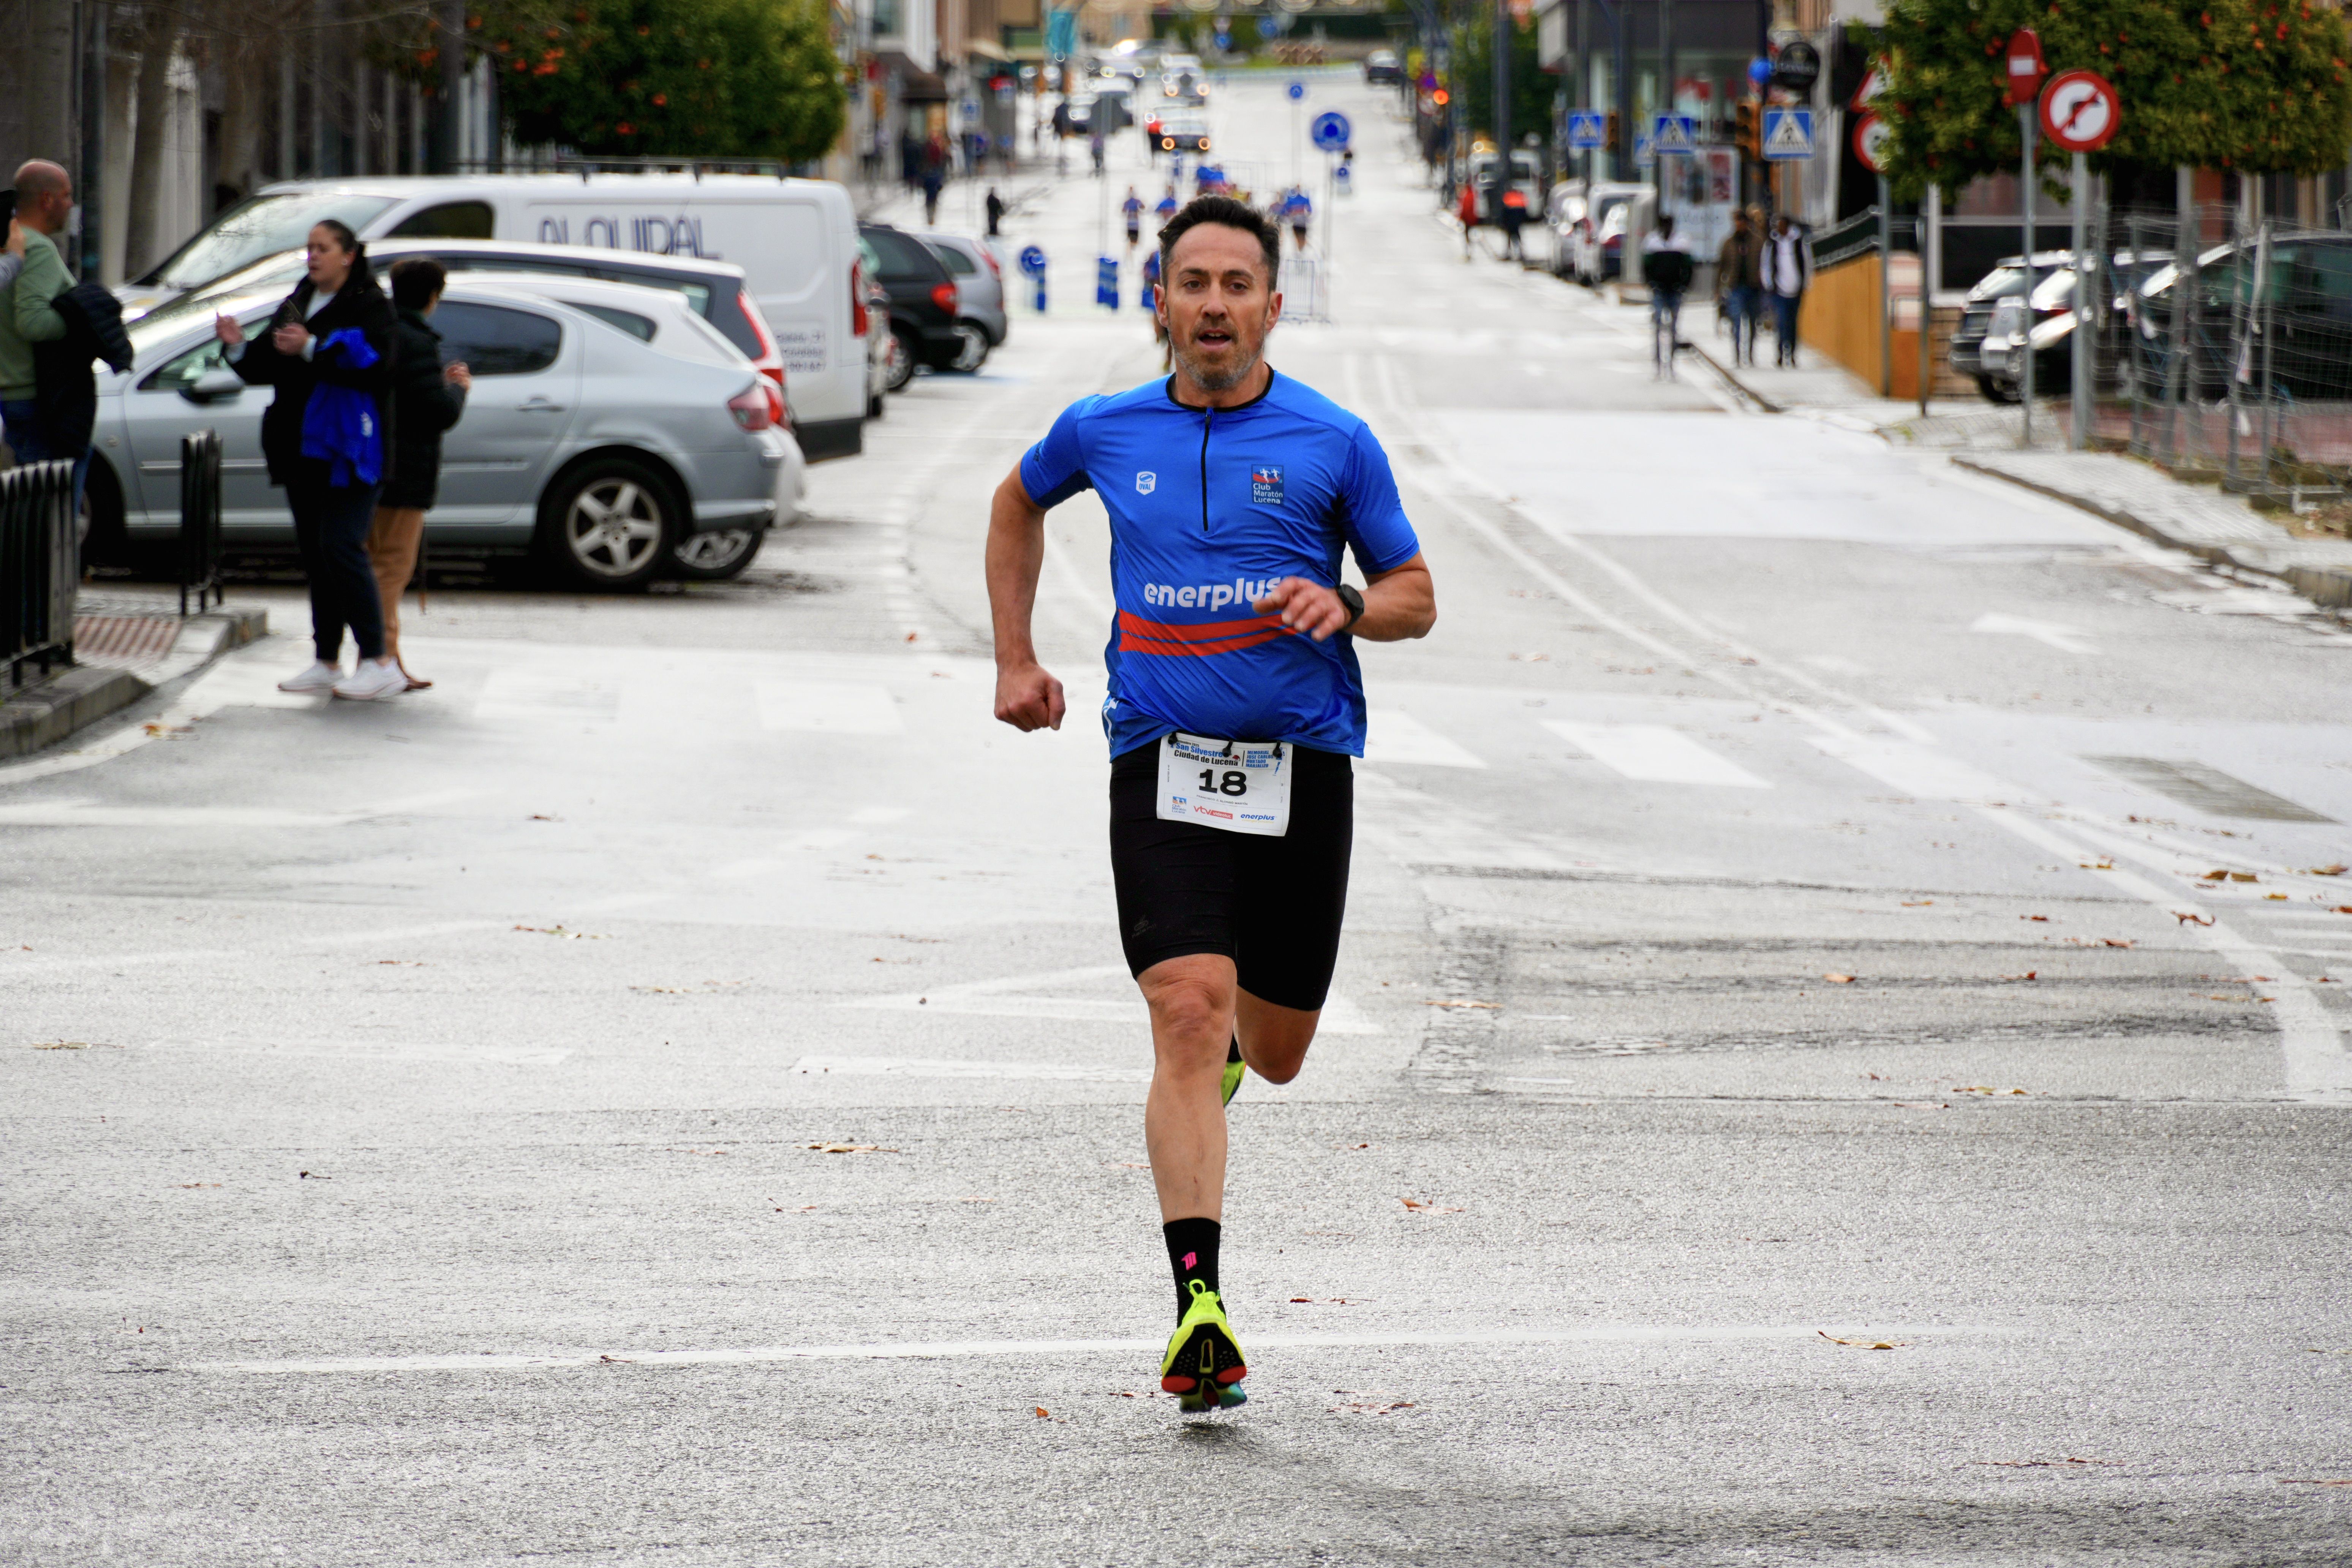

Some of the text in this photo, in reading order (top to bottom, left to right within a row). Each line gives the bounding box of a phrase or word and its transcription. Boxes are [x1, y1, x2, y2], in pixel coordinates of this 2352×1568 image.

[1254, 490, 1283, 498] Maratón
[1174, 749, 1199, 761] Ciudad
[1211, 757, 1238, 766] Lucena
[1176, 742, 1189, 751] San
[1190, 746, 1223, 757] Silvestre
[1199, 769, 1247, 796] 18
